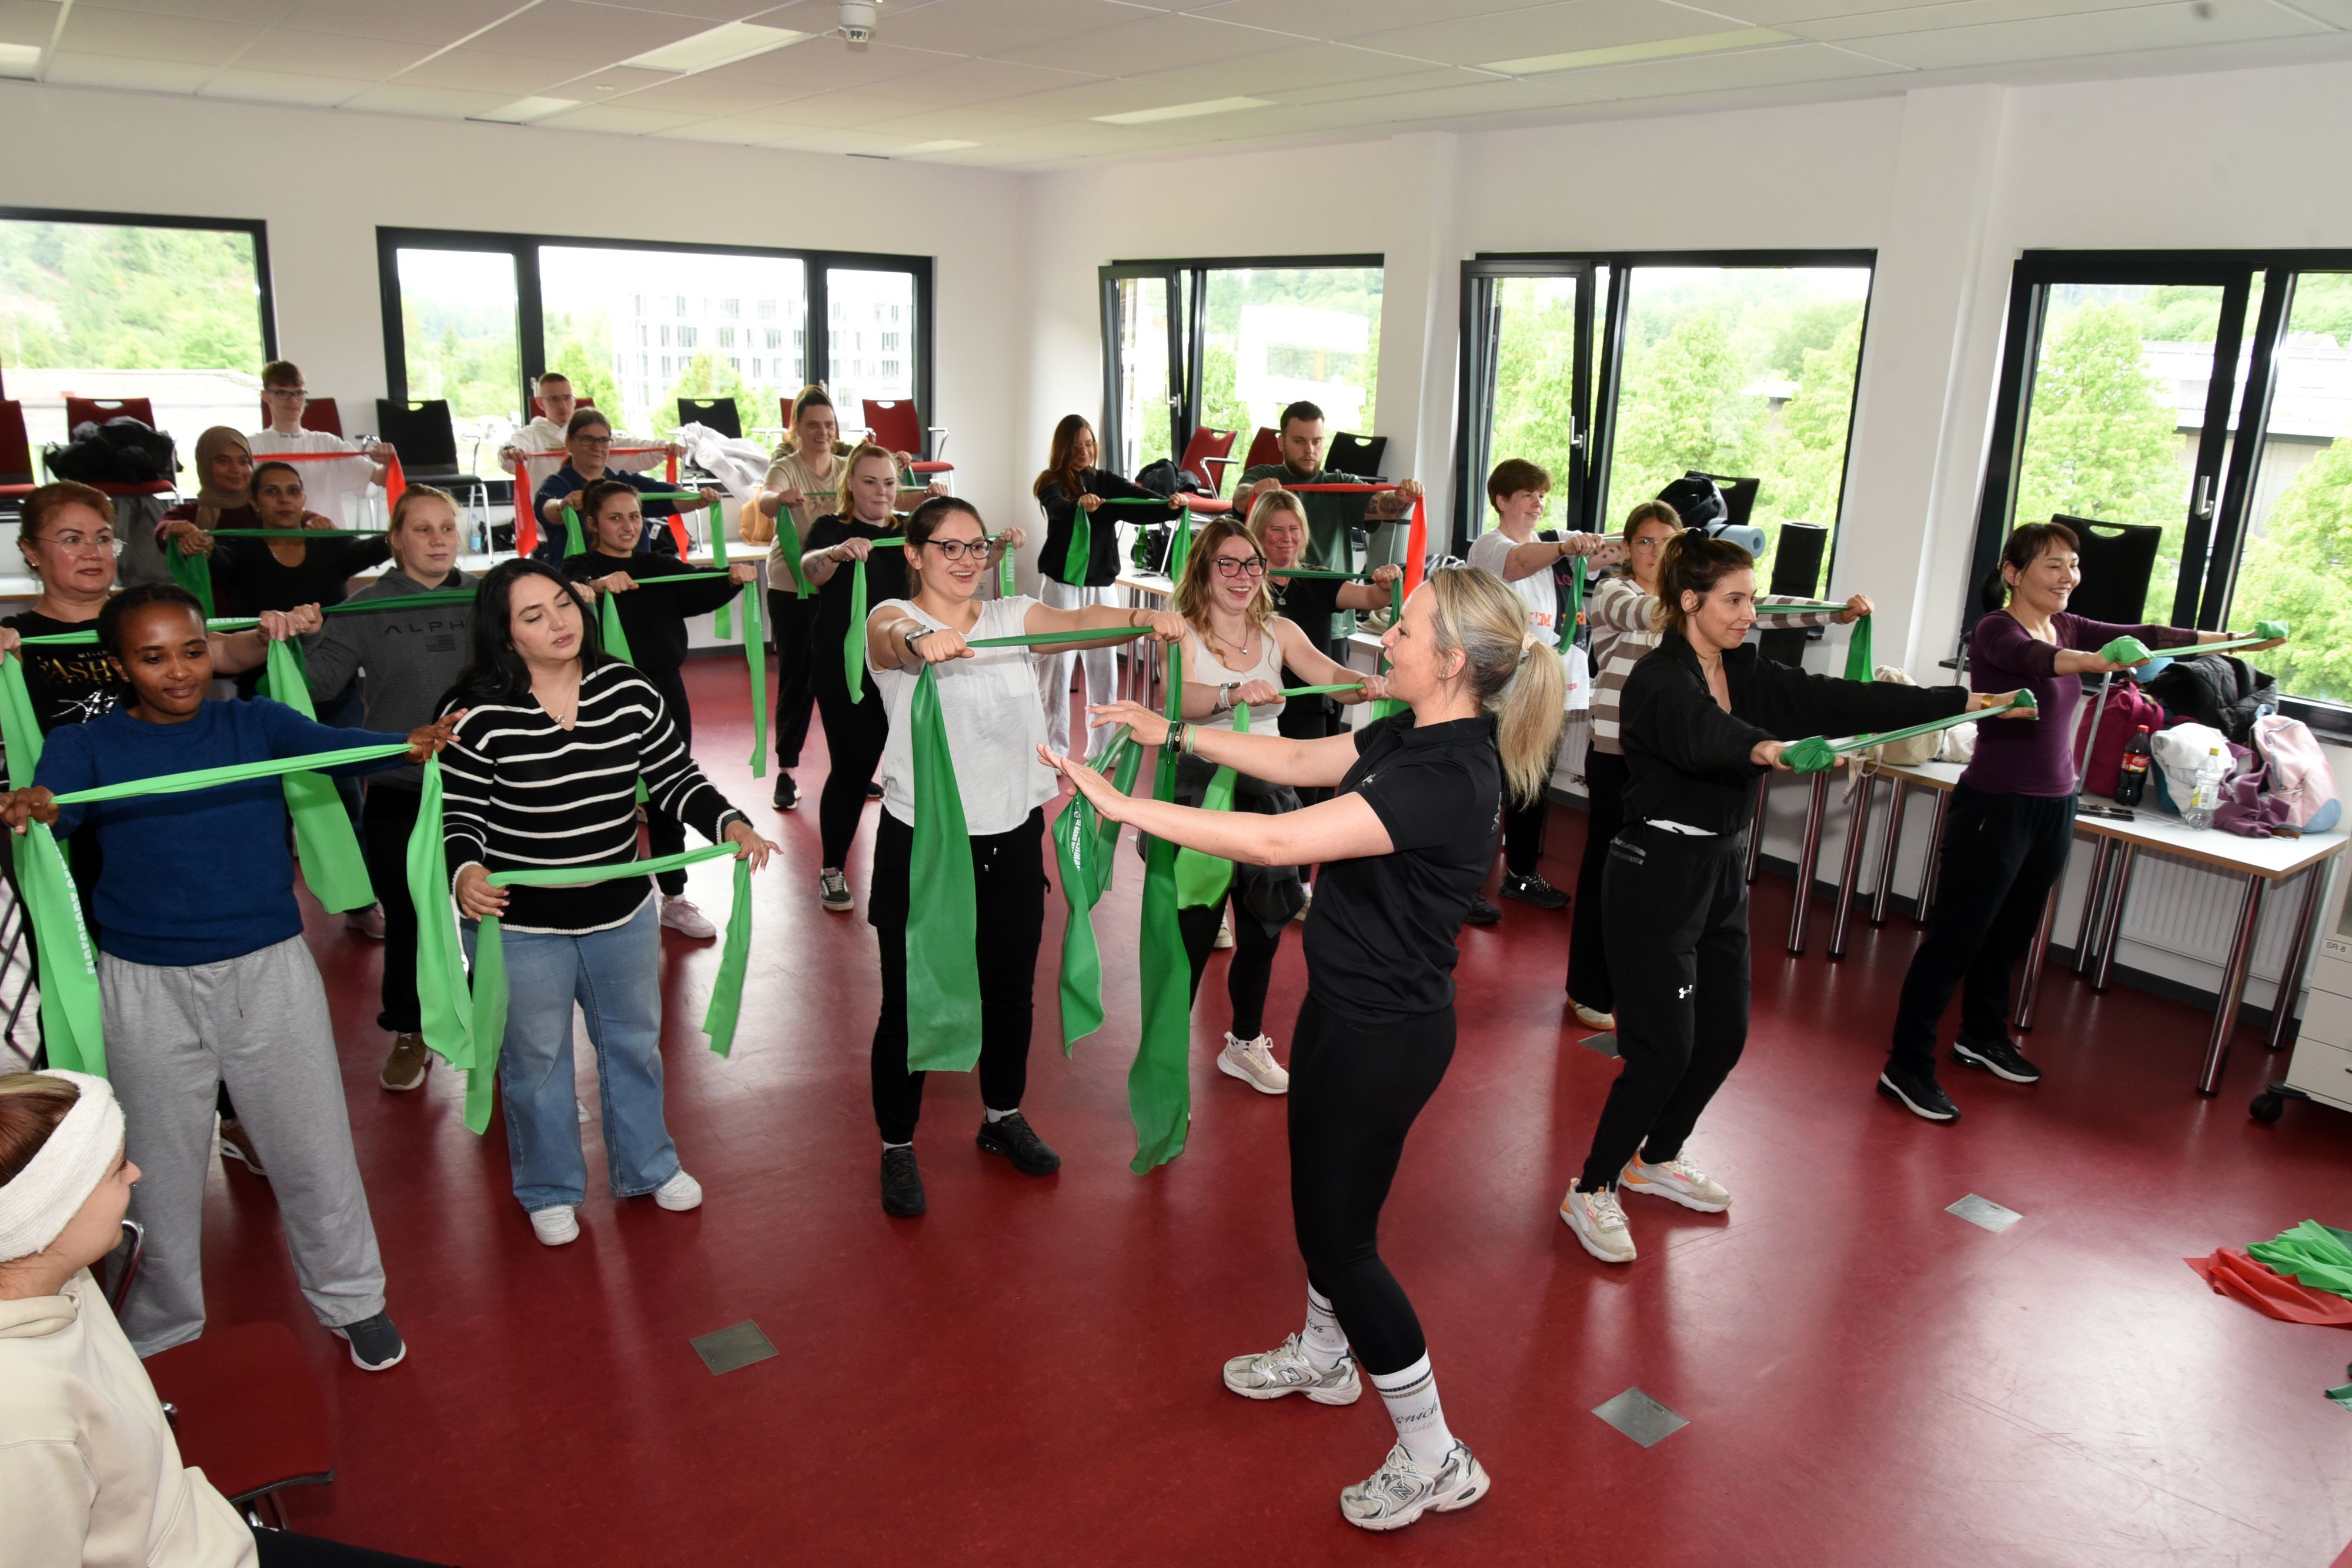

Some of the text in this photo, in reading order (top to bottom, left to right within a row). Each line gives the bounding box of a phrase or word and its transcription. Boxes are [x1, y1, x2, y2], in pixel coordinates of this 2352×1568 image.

[1005, 547, 1014, 583] GERMANY
[1555, 574, 1572, 586] LO
[385, 620, 465, 634] ALPH
[1072, 826, 1080, 841] BAND
[2326, 942, 2338, 950] SR
[1278, 1368, 1302, 1384] N
[1389, 1480, 1415, 1500] N
